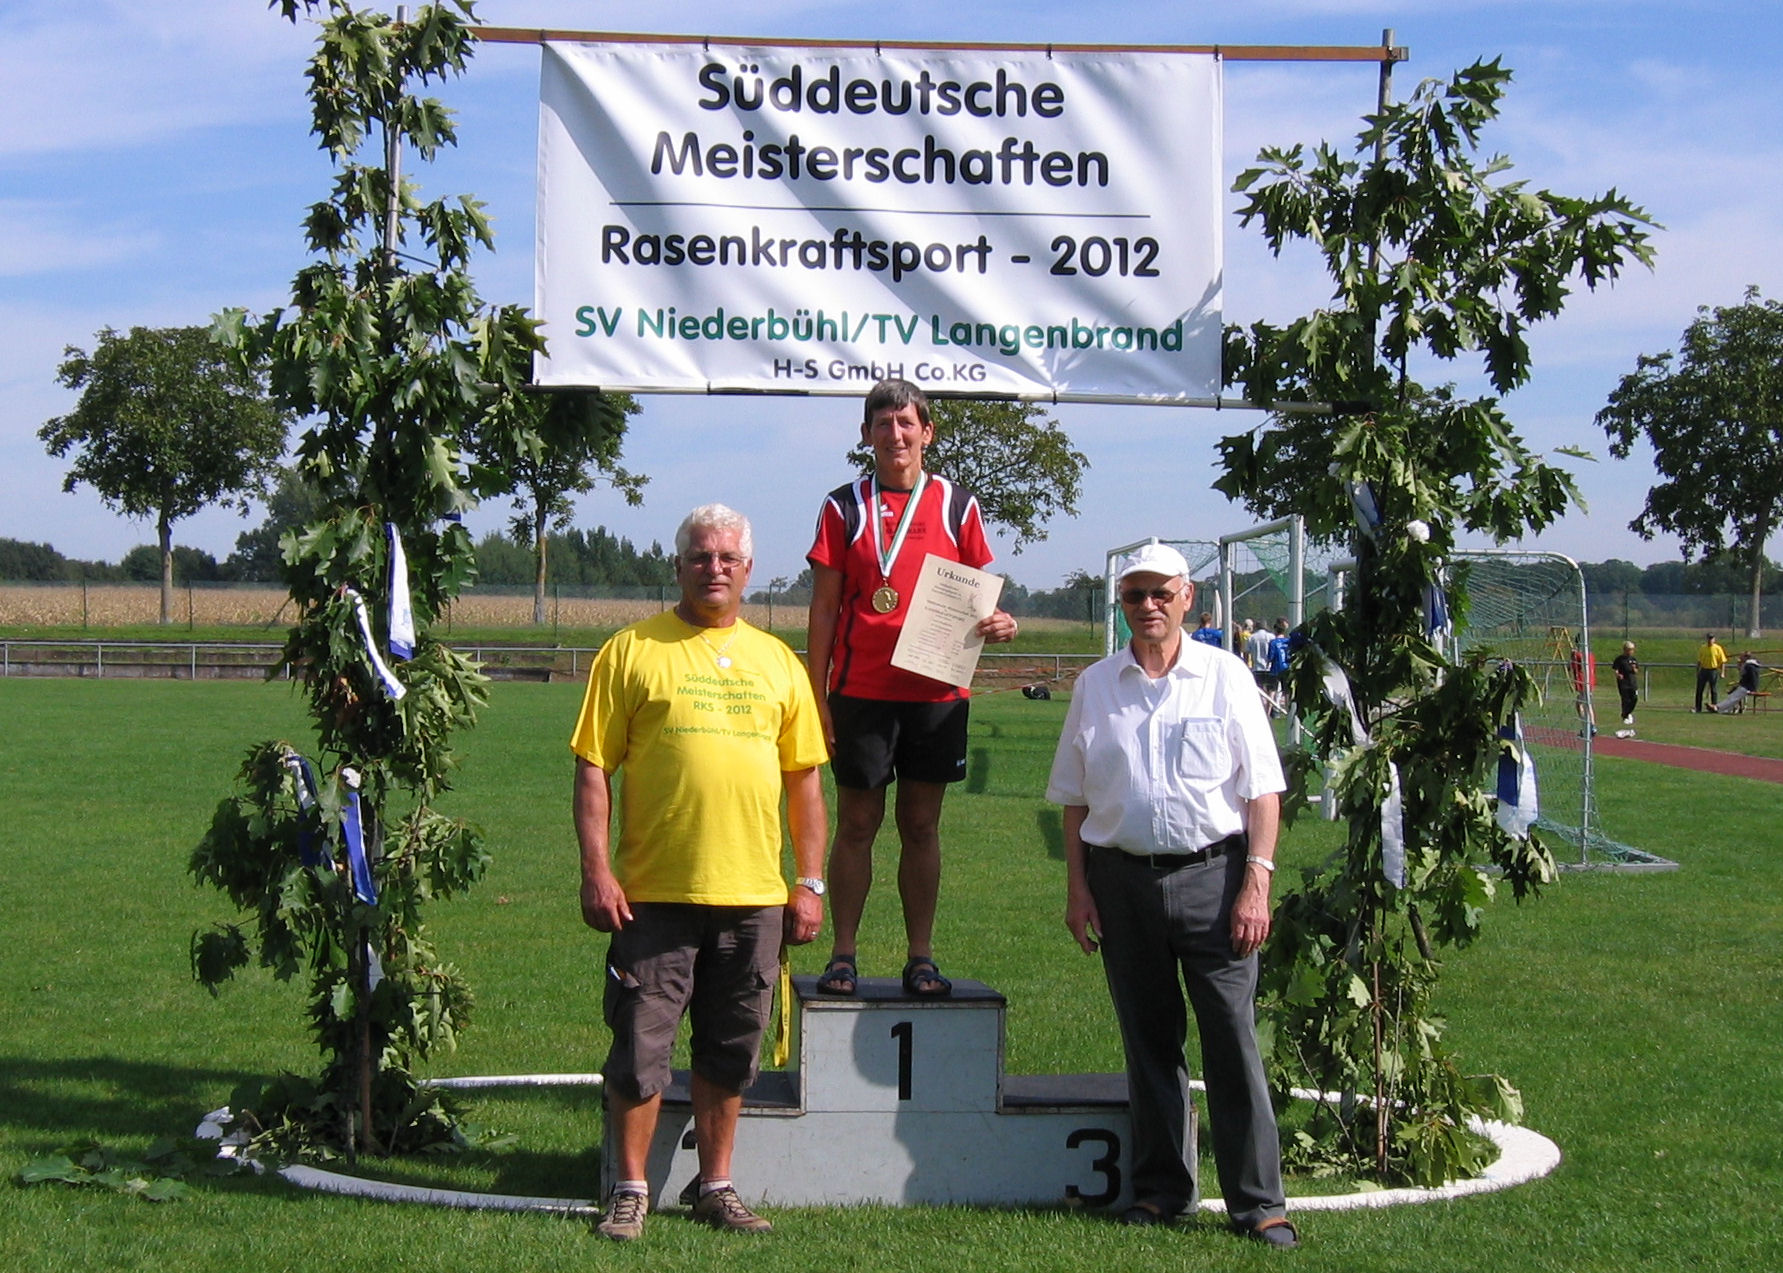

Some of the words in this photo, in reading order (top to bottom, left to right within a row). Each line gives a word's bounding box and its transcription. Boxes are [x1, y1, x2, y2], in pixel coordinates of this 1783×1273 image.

[698, 62, 1065, 118] Süddeutsche
[651, 130, 1109, 187] Meisterschaften
[601, 224, 992, 282] Rasenkraftsport
[1010, 254, 1031, 264] -
[1050, 235, 1161, 277] 2012
[574, 305, 622, 338] SV
[637, 307, 918, 345] Niederbühl/TV
[932, 315, 1184, 354] Langenbrand
[773, 358, 818, 380] H-S
[828, 359, 904, 382] GmbH
[914, 362, 987, 382] Co.KG
[936, 567, 981, 589] Urkunde
[676, 686, 766, 701] Meisterschaften
[685, 673, 754, 687] Süddeutsche
[693, 701, 714, 713] RKS
[726, 704, 752, 715] 2012
[891, 1021, 912, 1100] 1
[1066, 1128, 1121, 1207] 3
